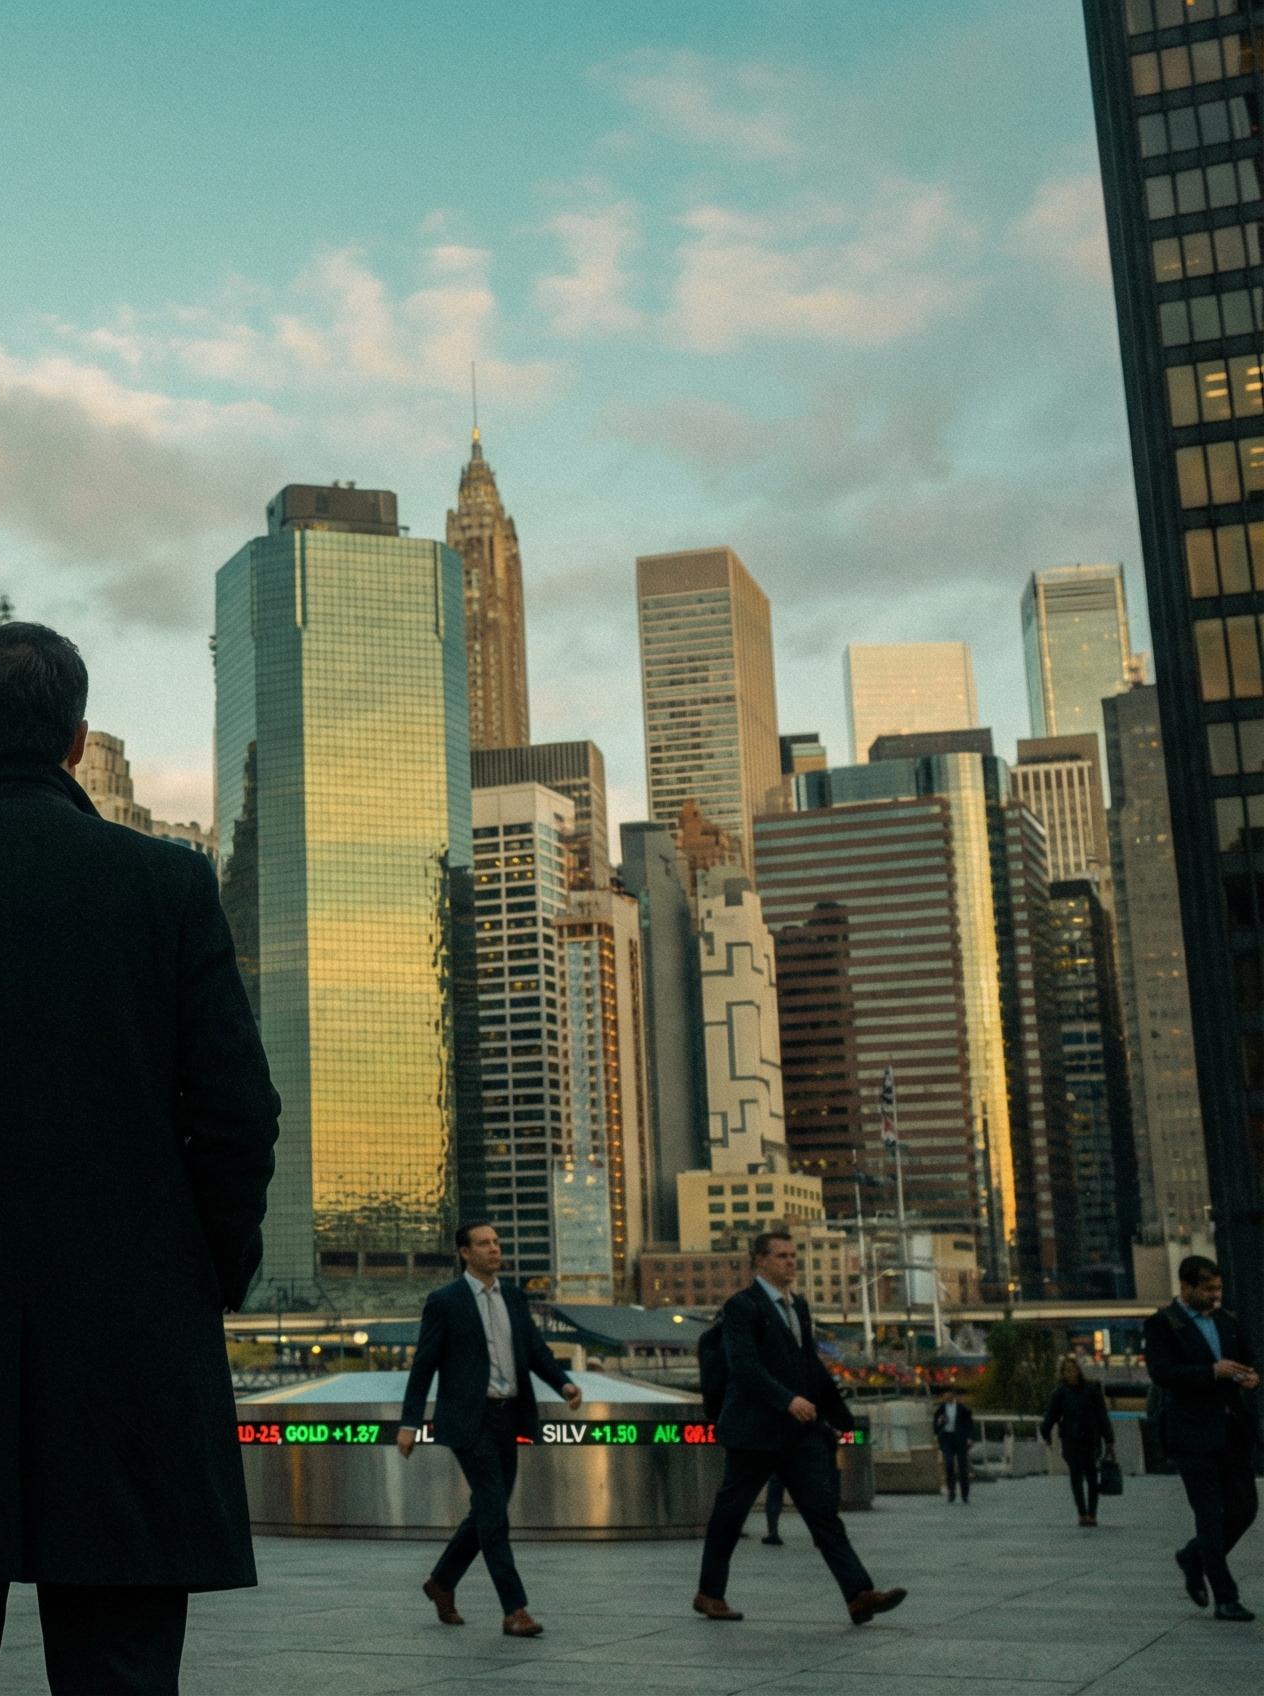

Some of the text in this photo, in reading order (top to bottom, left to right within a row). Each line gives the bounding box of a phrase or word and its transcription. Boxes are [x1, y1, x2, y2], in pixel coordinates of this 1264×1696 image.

[285, 1425, 329, 1442] GOLD
[542, 1424, 587, 1443] SILV
[591, 1424, 637, 1443] +1.50
